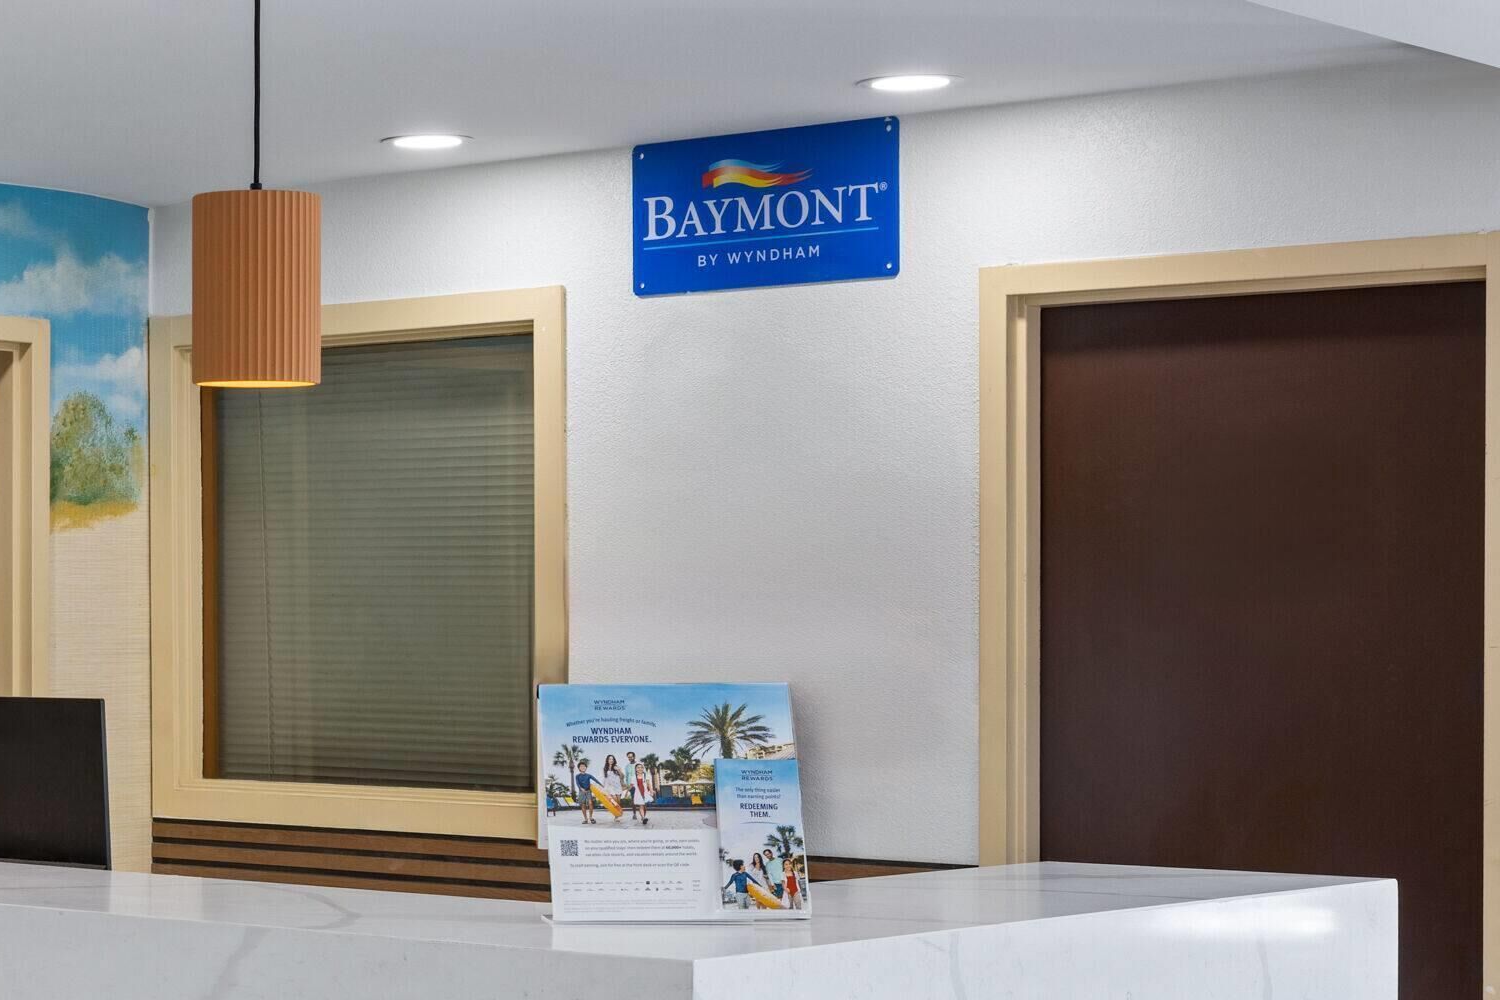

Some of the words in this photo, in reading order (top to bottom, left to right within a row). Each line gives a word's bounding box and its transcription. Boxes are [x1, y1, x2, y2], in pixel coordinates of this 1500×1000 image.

[697, 254, 717, 267] BY
[728, 245, 820, 264] WYNDHAM
[590, 727, 632, 735] WYNDHAM
[572, 735, 609, 743] REWARDS
[611, 735, 652, 743] EVERYONE.
